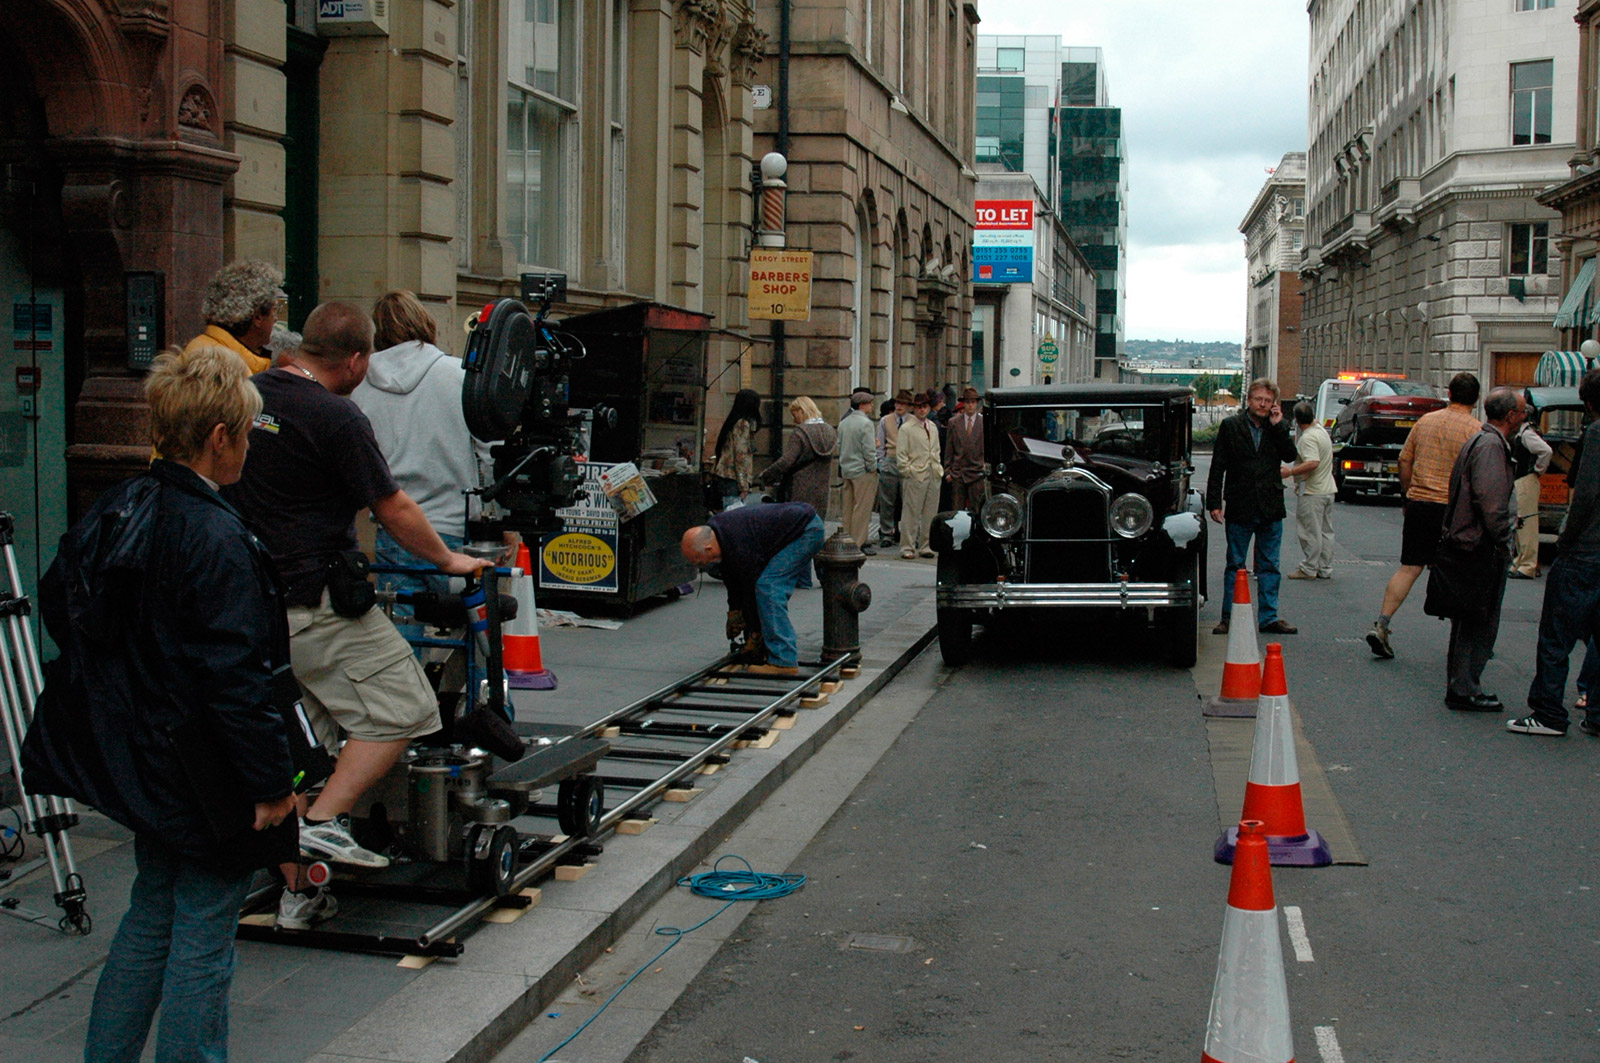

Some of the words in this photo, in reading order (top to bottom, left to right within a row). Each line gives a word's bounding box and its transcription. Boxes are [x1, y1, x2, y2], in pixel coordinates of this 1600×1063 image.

[320, 2, 344, 15] ADT
[976, 208, 997, 221] TO
[1001, 208, 1029, 221] LET
[751, 271, 809, 283] BARBERS
[762, 284, 797, 295] SHOP
[586, 510, 600, 518] DAVID
[559, 543, 602, 551] HITCHCOCK'S
